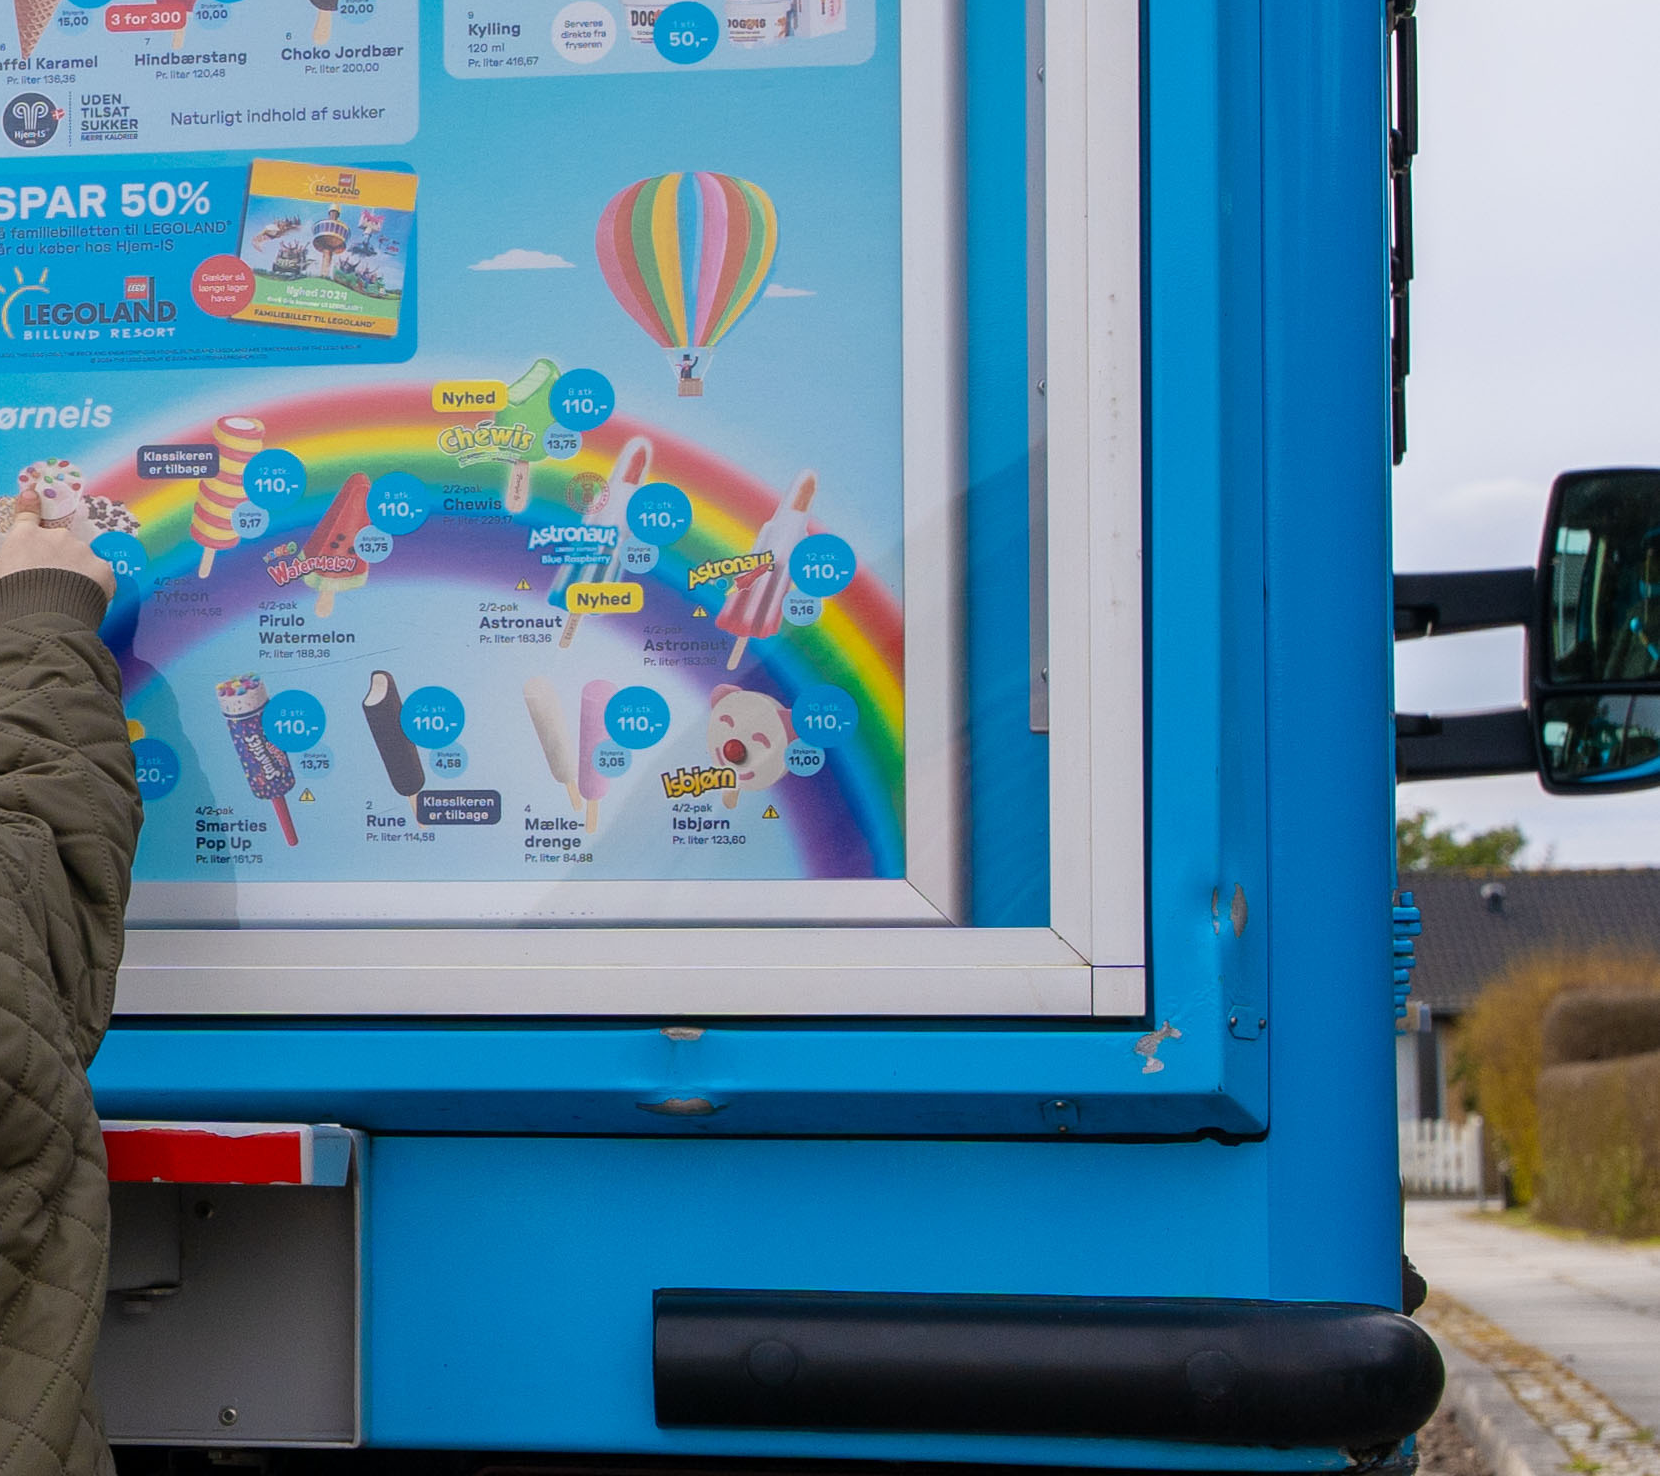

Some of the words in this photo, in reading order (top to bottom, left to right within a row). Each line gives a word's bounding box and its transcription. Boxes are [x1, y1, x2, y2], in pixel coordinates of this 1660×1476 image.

[469, 23, 520, 38] Kylling
[135, 52, 246, 66] Hindbærstang
[171, 110, 242, 126] Naturligt
[246, 107, 306, 122] indhold
[310, 106, 327, 121] af
[333, 106, 385, 120] sukker
[122, 182, 209, 216] 50%
[24, 330, 99, 340] BILLUND
[111, 328, 175, 338] RESORT
[443, 391, 495, 407] Nyhed
[260, 614, 304, 626] Pirulo
[480, 616, 562, 628] Astronaut
[259, 631, 354, 644] Watermelon
[367, 815, 406, 827] Rune
[673, 817, 729, 832] Isbjørn
